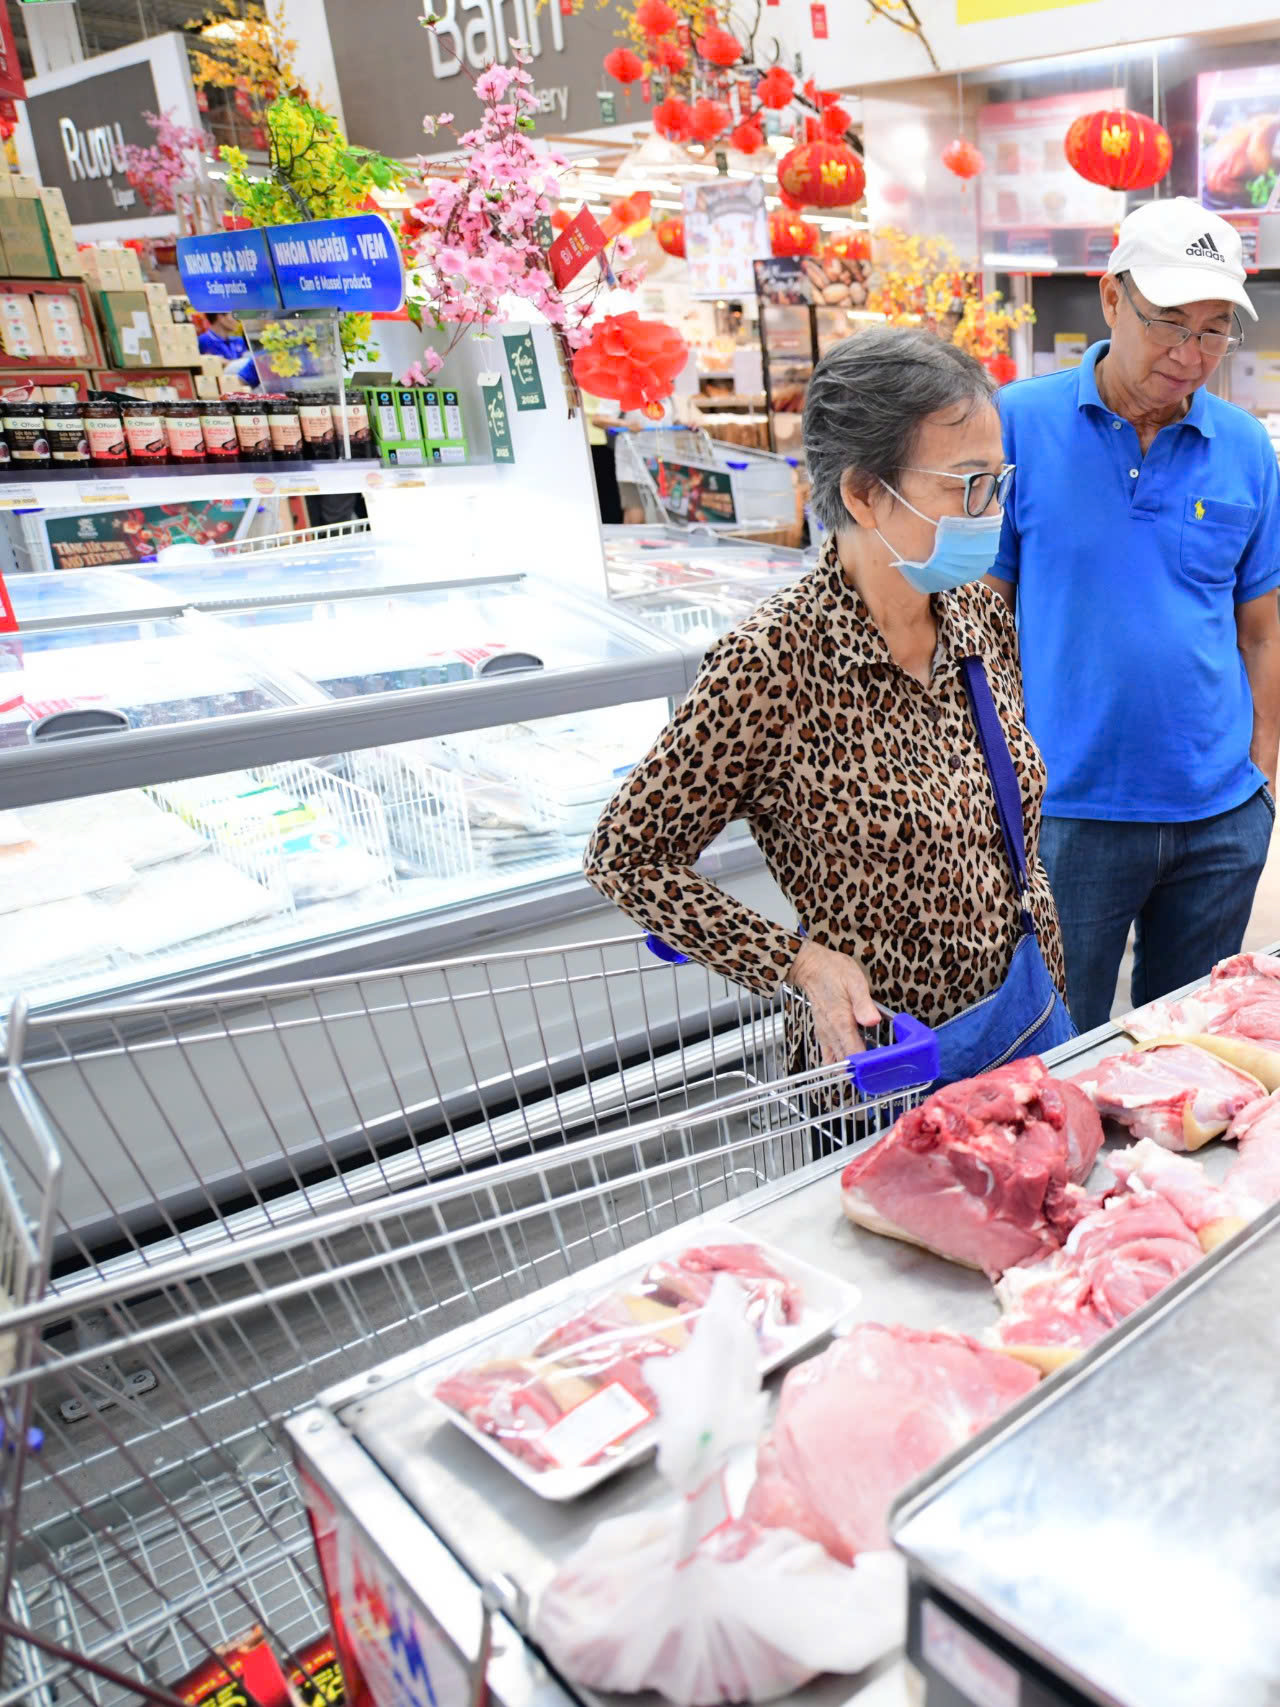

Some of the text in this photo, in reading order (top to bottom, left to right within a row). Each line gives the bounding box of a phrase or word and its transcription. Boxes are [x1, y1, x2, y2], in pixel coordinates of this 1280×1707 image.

[274, 236, 309, 266] NHÓM
[356, 232, 389, 266] VẸM
[1185, 246, 1225, 263] adidas
[341, 272, 373, 295] products
[520, 394, 541, 406] 2025
